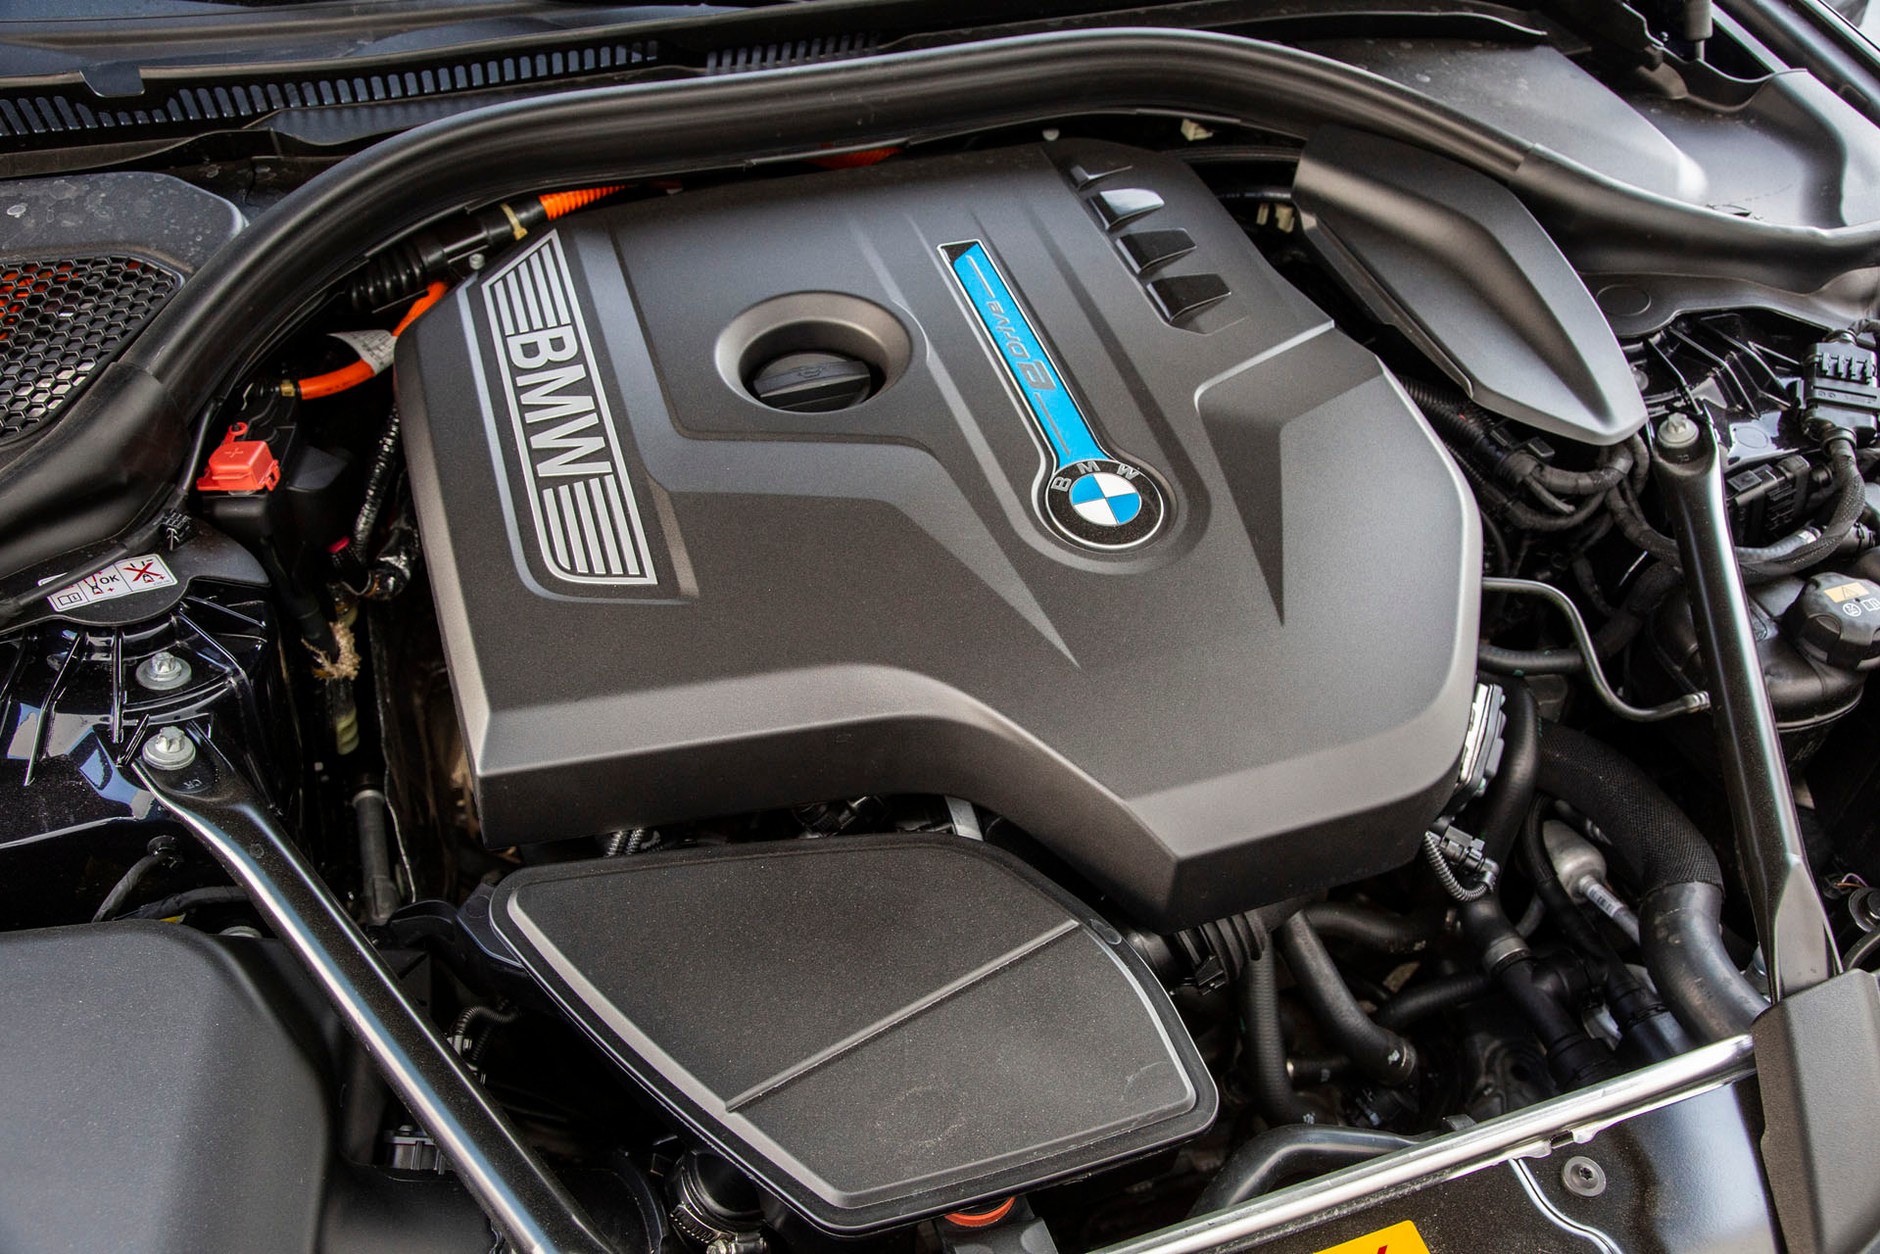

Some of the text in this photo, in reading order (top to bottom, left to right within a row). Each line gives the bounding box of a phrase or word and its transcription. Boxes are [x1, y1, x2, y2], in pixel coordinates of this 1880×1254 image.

[507, 324, 613, 478] BMW
[1050, 460, 1140, 492] BMW
[99, 574, 120, 585] OK
